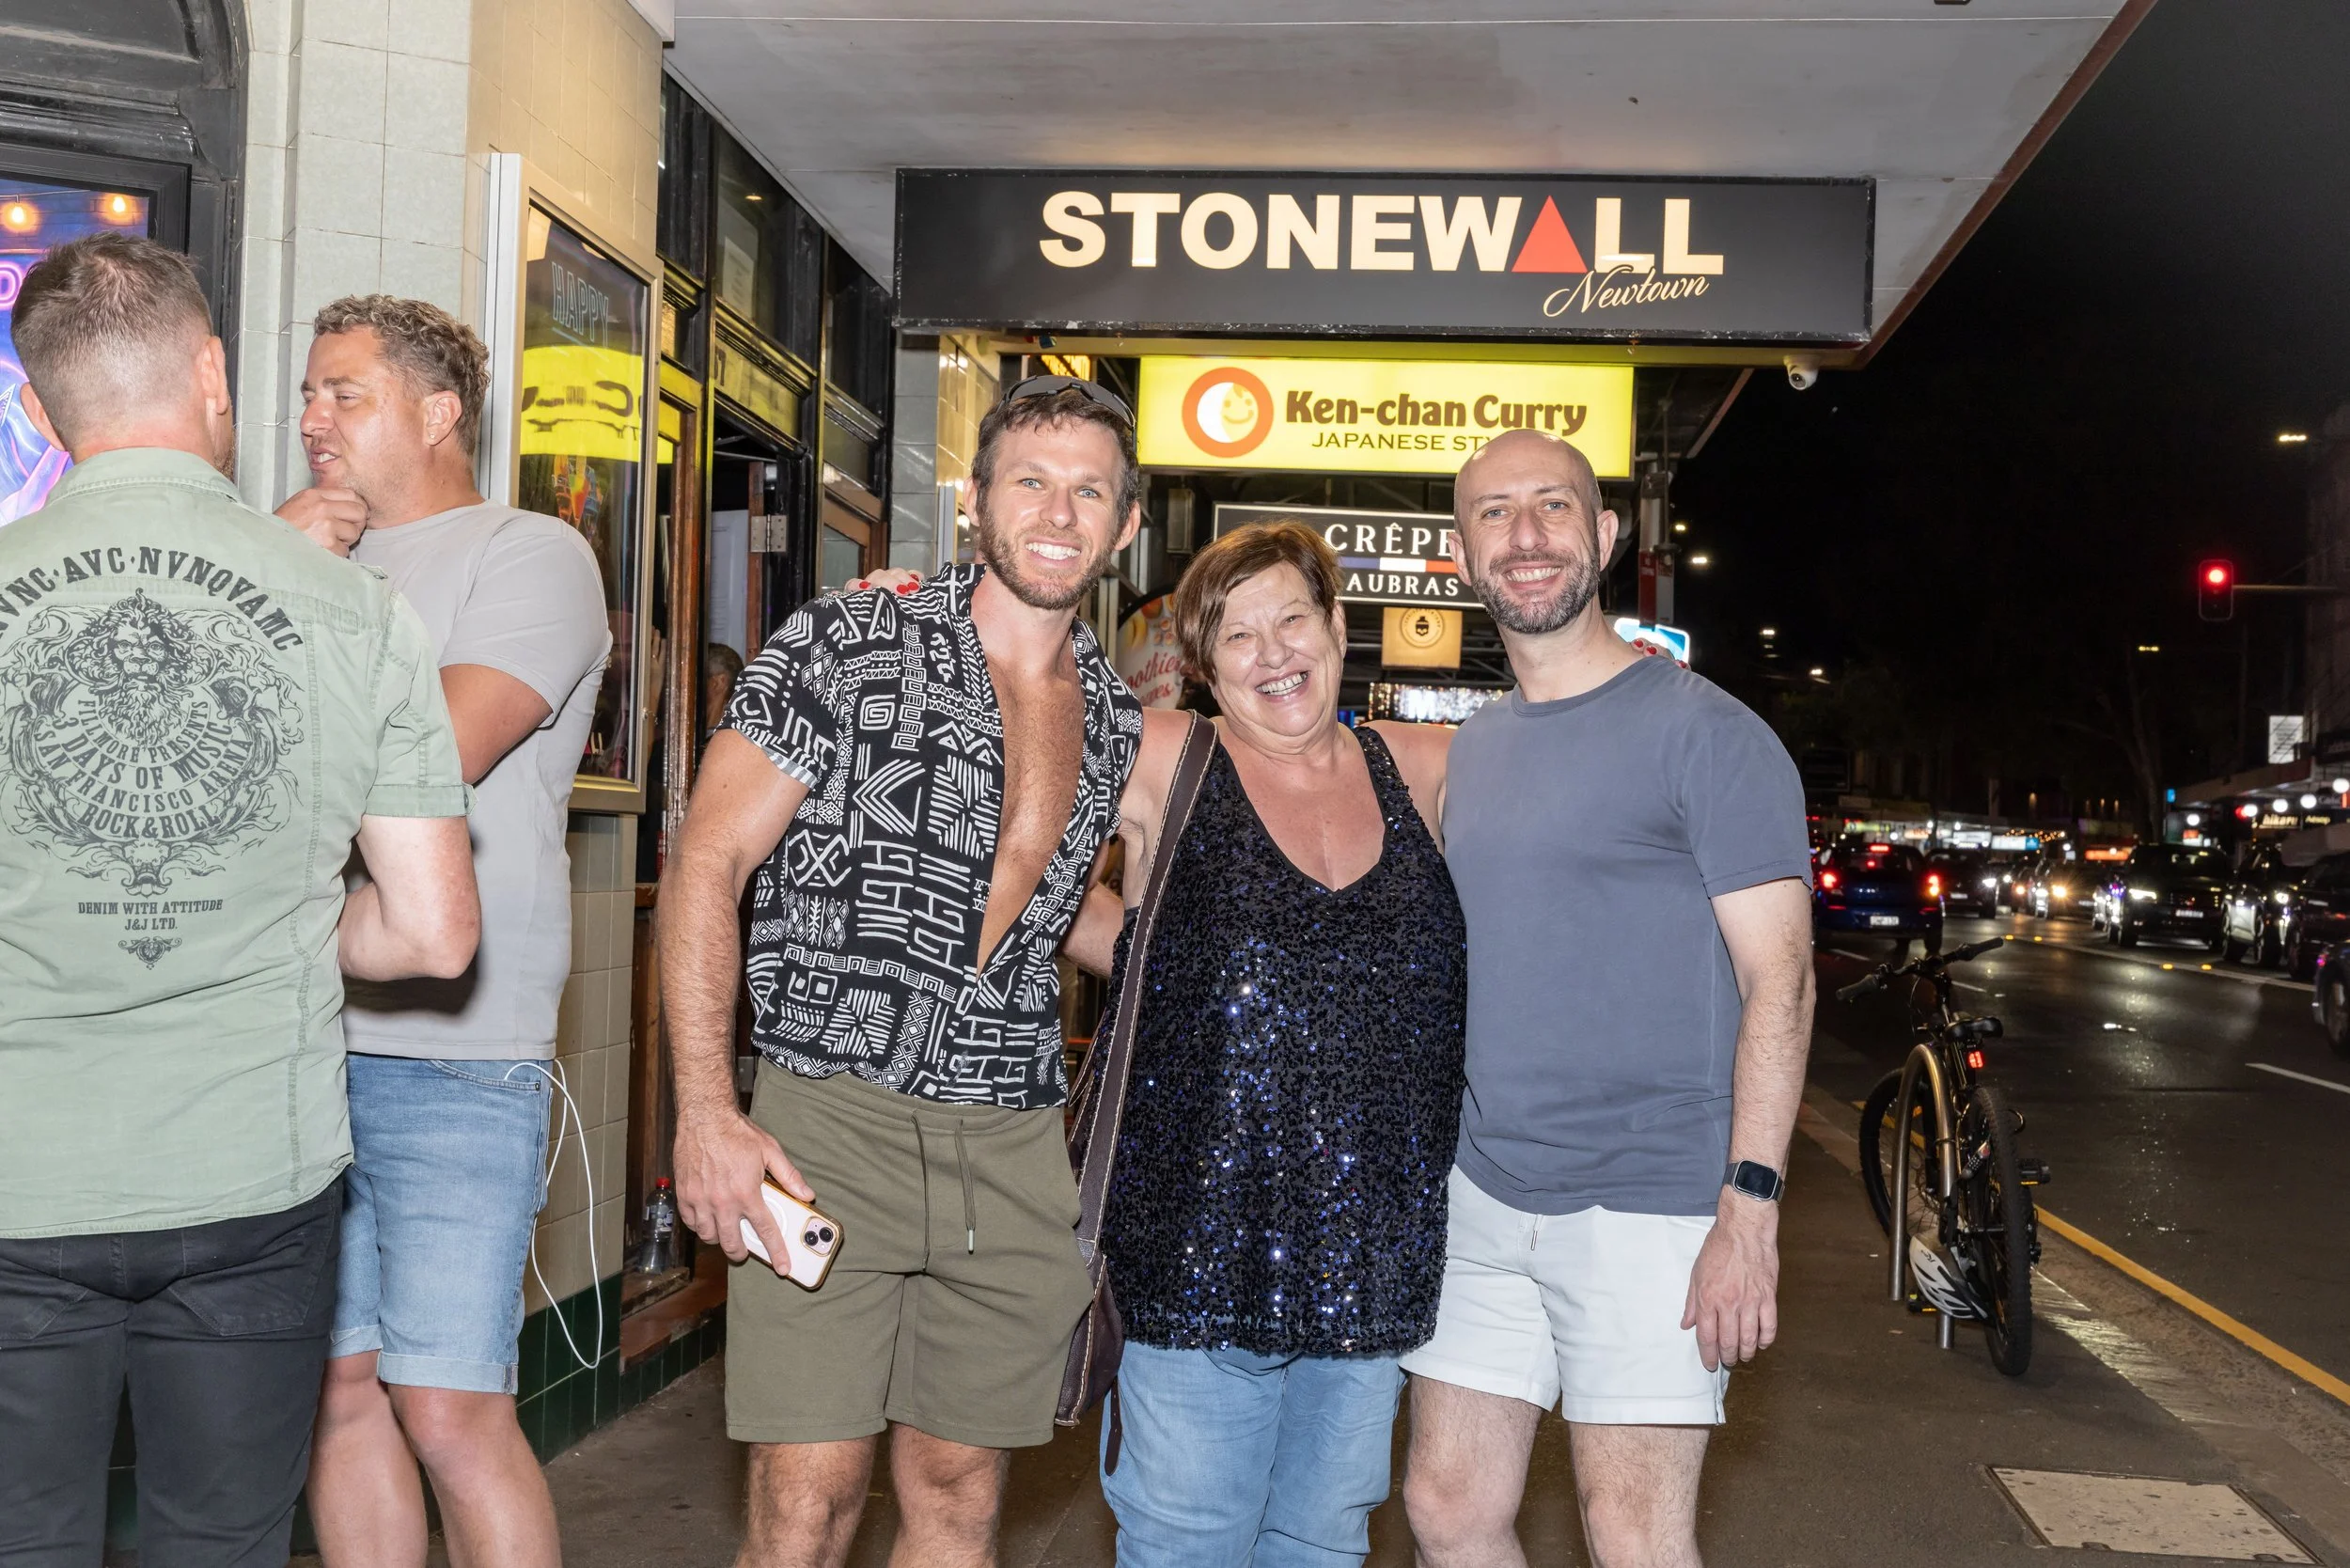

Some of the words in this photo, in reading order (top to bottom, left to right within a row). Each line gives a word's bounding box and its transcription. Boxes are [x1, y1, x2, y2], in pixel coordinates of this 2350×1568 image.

[1039, 191, 1724, 274] STONEWALL
[552, 261, 609, 350] HAPPY
[1543, 265, 1709, 318] Newtown
[1286, 390, 1466, 427] Ken-chan
[1474, 395, 1588, 436] Curry
[1311, 431, 1445, 450] JAPANESE
[1452, 435, 1490, 451] ST
[1346, 572, 1459, 597] AUBRAS
[53, 716, 79, 730] 3
[78, 699, 139, 762] FILLMORE
[34, 729, 71, 770] SAN
[65, 769, 194, 813] FRANCISCO
[200, 739, 253, 797] ARENA
[61, 732, 127, 784] DAYS
[170, 721, 233, 782] MUSIC
[135, 766, 163, 790] OF
[78, 902, 118, 915] DENIM
[122, 902, 158, 915] WITH
[162, 899, 223, 914] ATTITUDE
[124, 917, 148, 931] J&J
[151, 917, 178, 931] LTD.
